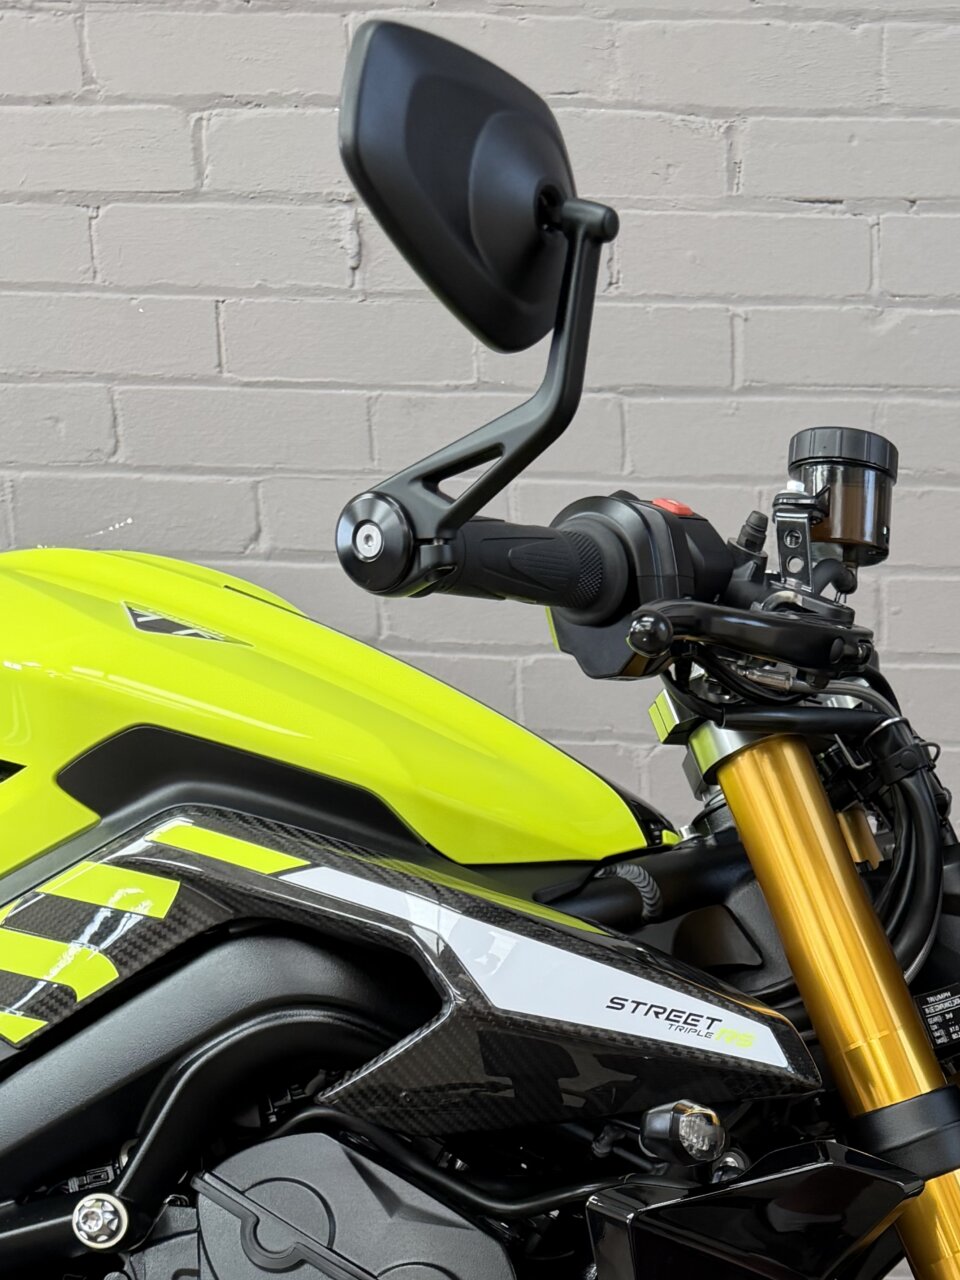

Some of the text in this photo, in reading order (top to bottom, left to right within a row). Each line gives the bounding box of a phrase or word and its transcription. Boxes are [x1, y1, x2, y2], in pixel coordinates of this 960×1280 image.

[605, 996, 723, 1030] STREET
[668, 1023, 755, 1048] TRIPLE RS
